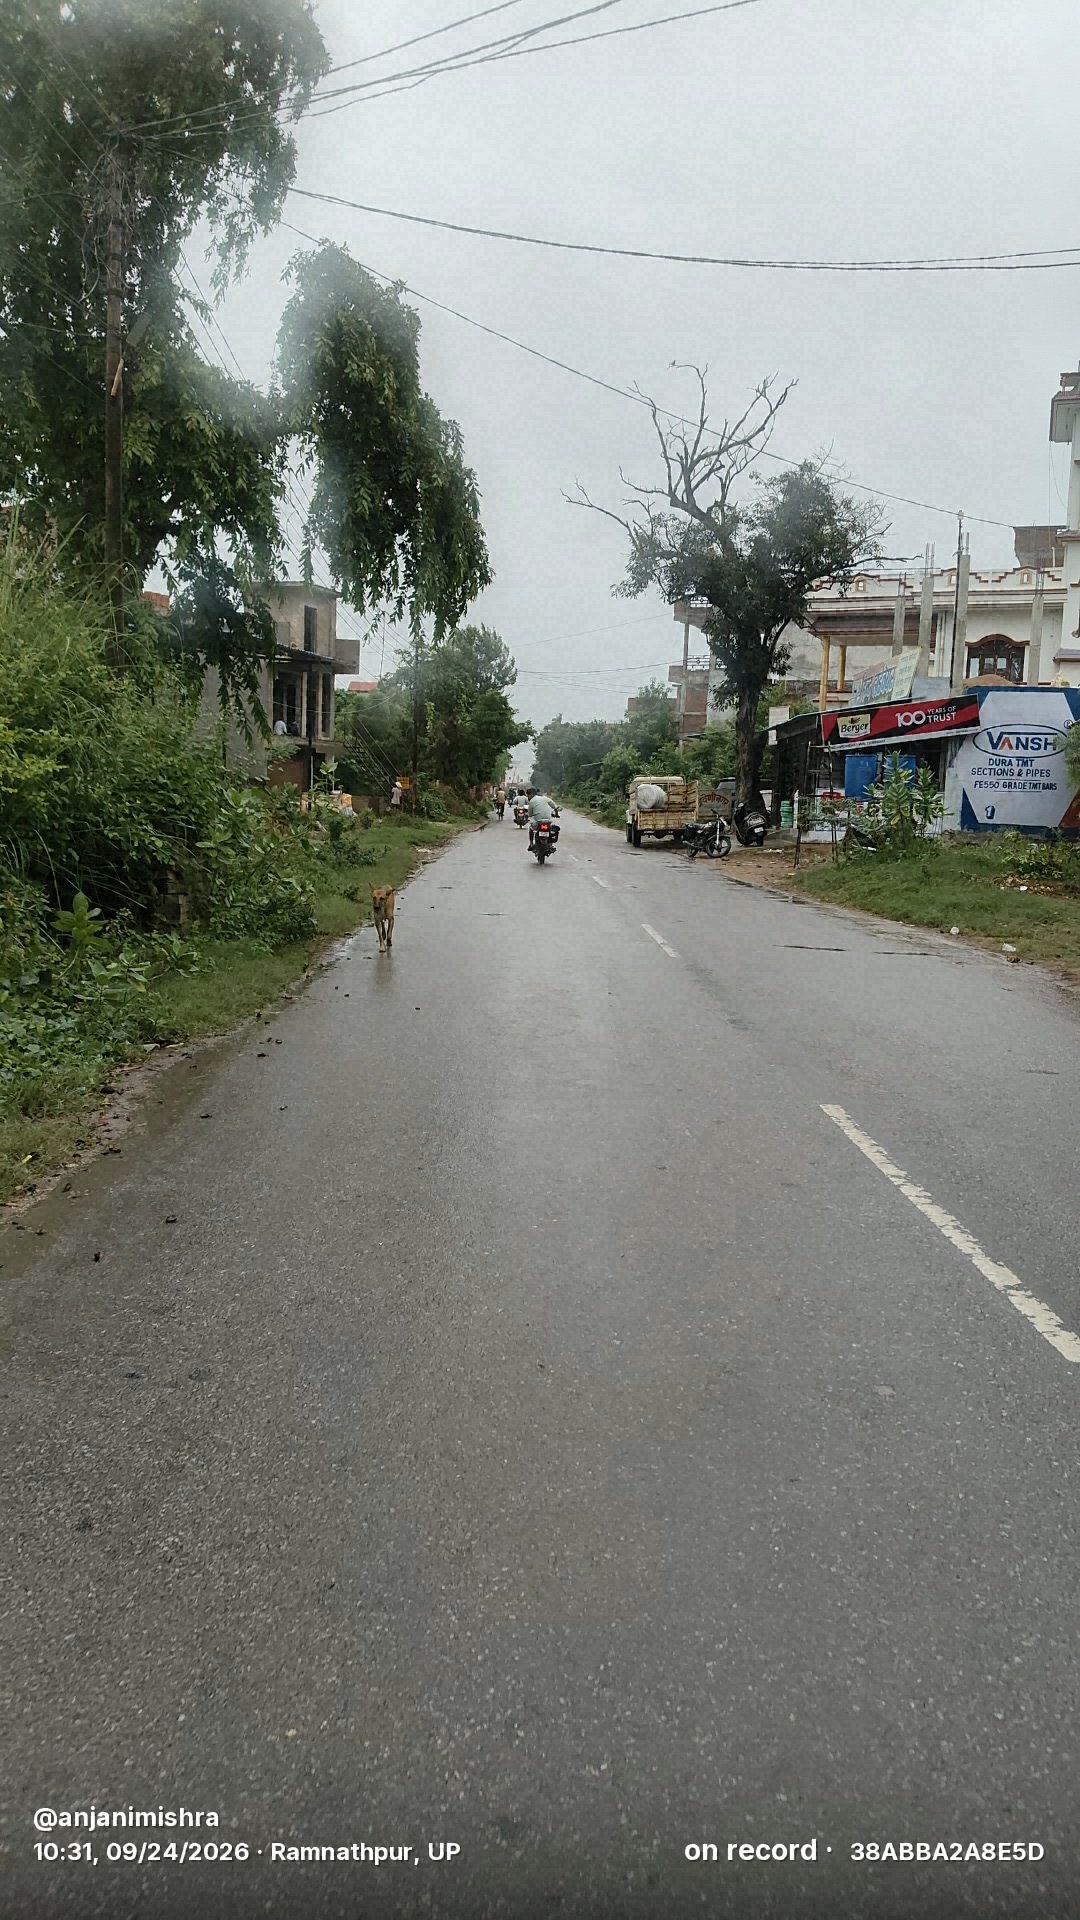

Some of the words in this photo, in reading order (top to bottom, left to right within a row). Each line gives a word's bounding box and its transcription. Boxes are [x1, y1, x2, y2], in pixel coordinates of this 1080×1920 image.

[895, 710, 926, 728] 100
[928, 707, 947, 715] YEARS
[927, 712, 957, 723] TRUST
[841, 723, 869, 734] Berger
[986, 731, 1058, 751] VANSH
[988, 758, 1013, 767] DURA
[1015, 759, 1035, 768] TMT
[971, 767, 1015, 777] SECTIONS
[1017, 769, 1023, 778] &
[1026, 769, 1051, 778] PIPES
[974, 780, 999, 789] FE550
[1002, 781, 1027, 790] GRADE
